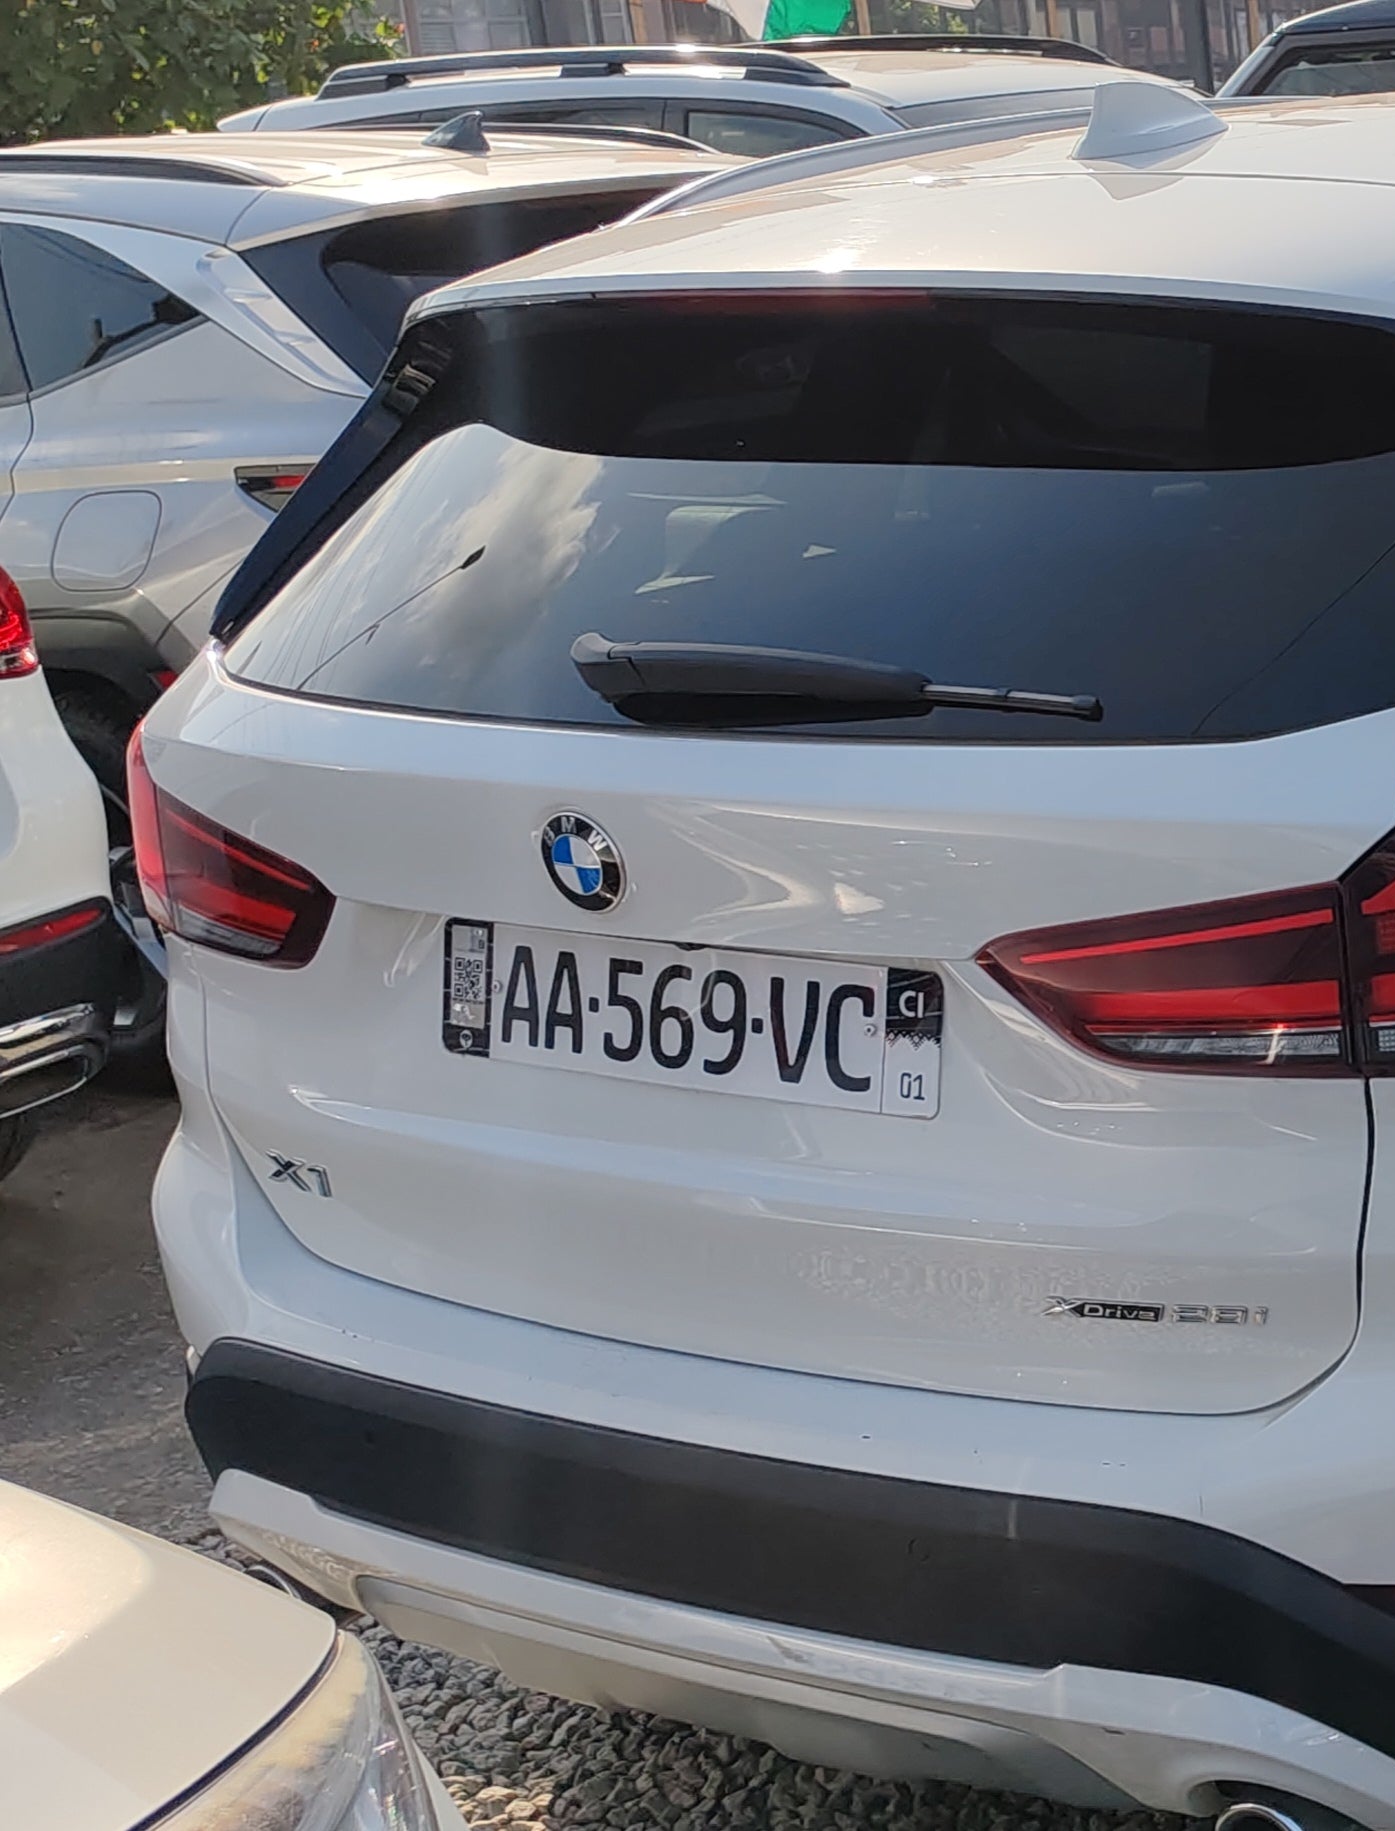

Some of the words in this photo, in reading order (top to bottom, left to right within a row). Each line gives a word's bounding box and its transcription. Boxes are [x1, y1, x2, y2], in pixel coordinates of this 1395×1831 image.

[898, 989, 924, 1018] CI
[900, 1072, 925, 1101] 01
[265, 1149, 333, 1198] X1
